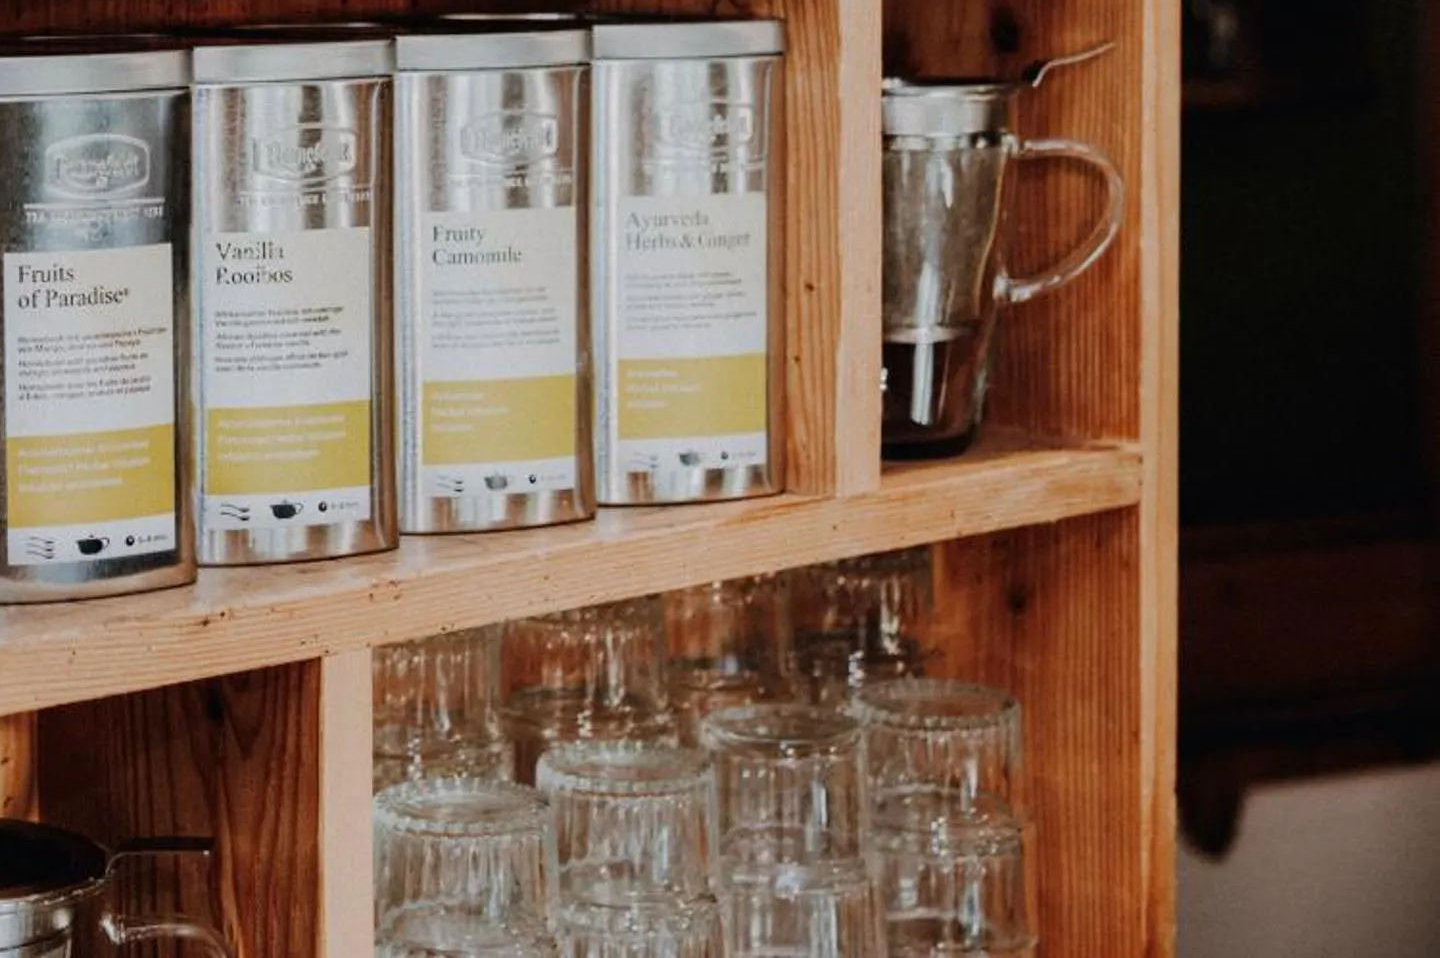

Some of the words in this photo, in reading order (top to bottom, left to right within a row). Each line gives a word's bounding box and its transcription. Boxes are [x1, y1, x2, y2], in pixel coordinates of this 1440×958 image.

[625, 209, 710, 231] Ayurveda
[432, 225, 485, 246] Fruity
[625, 233, 677, 251] Herbs
[679, 233, 694, 249] &
[216, 241, 285, 260] Vanilla
[432, 246, 524, 267] Camomile
[17, 263, 75, 284] Fruits
[216, 265, 294, 285] Rooibos
[17, 289, 41, 309] of
[45, 285, 124, 309] Paradise
